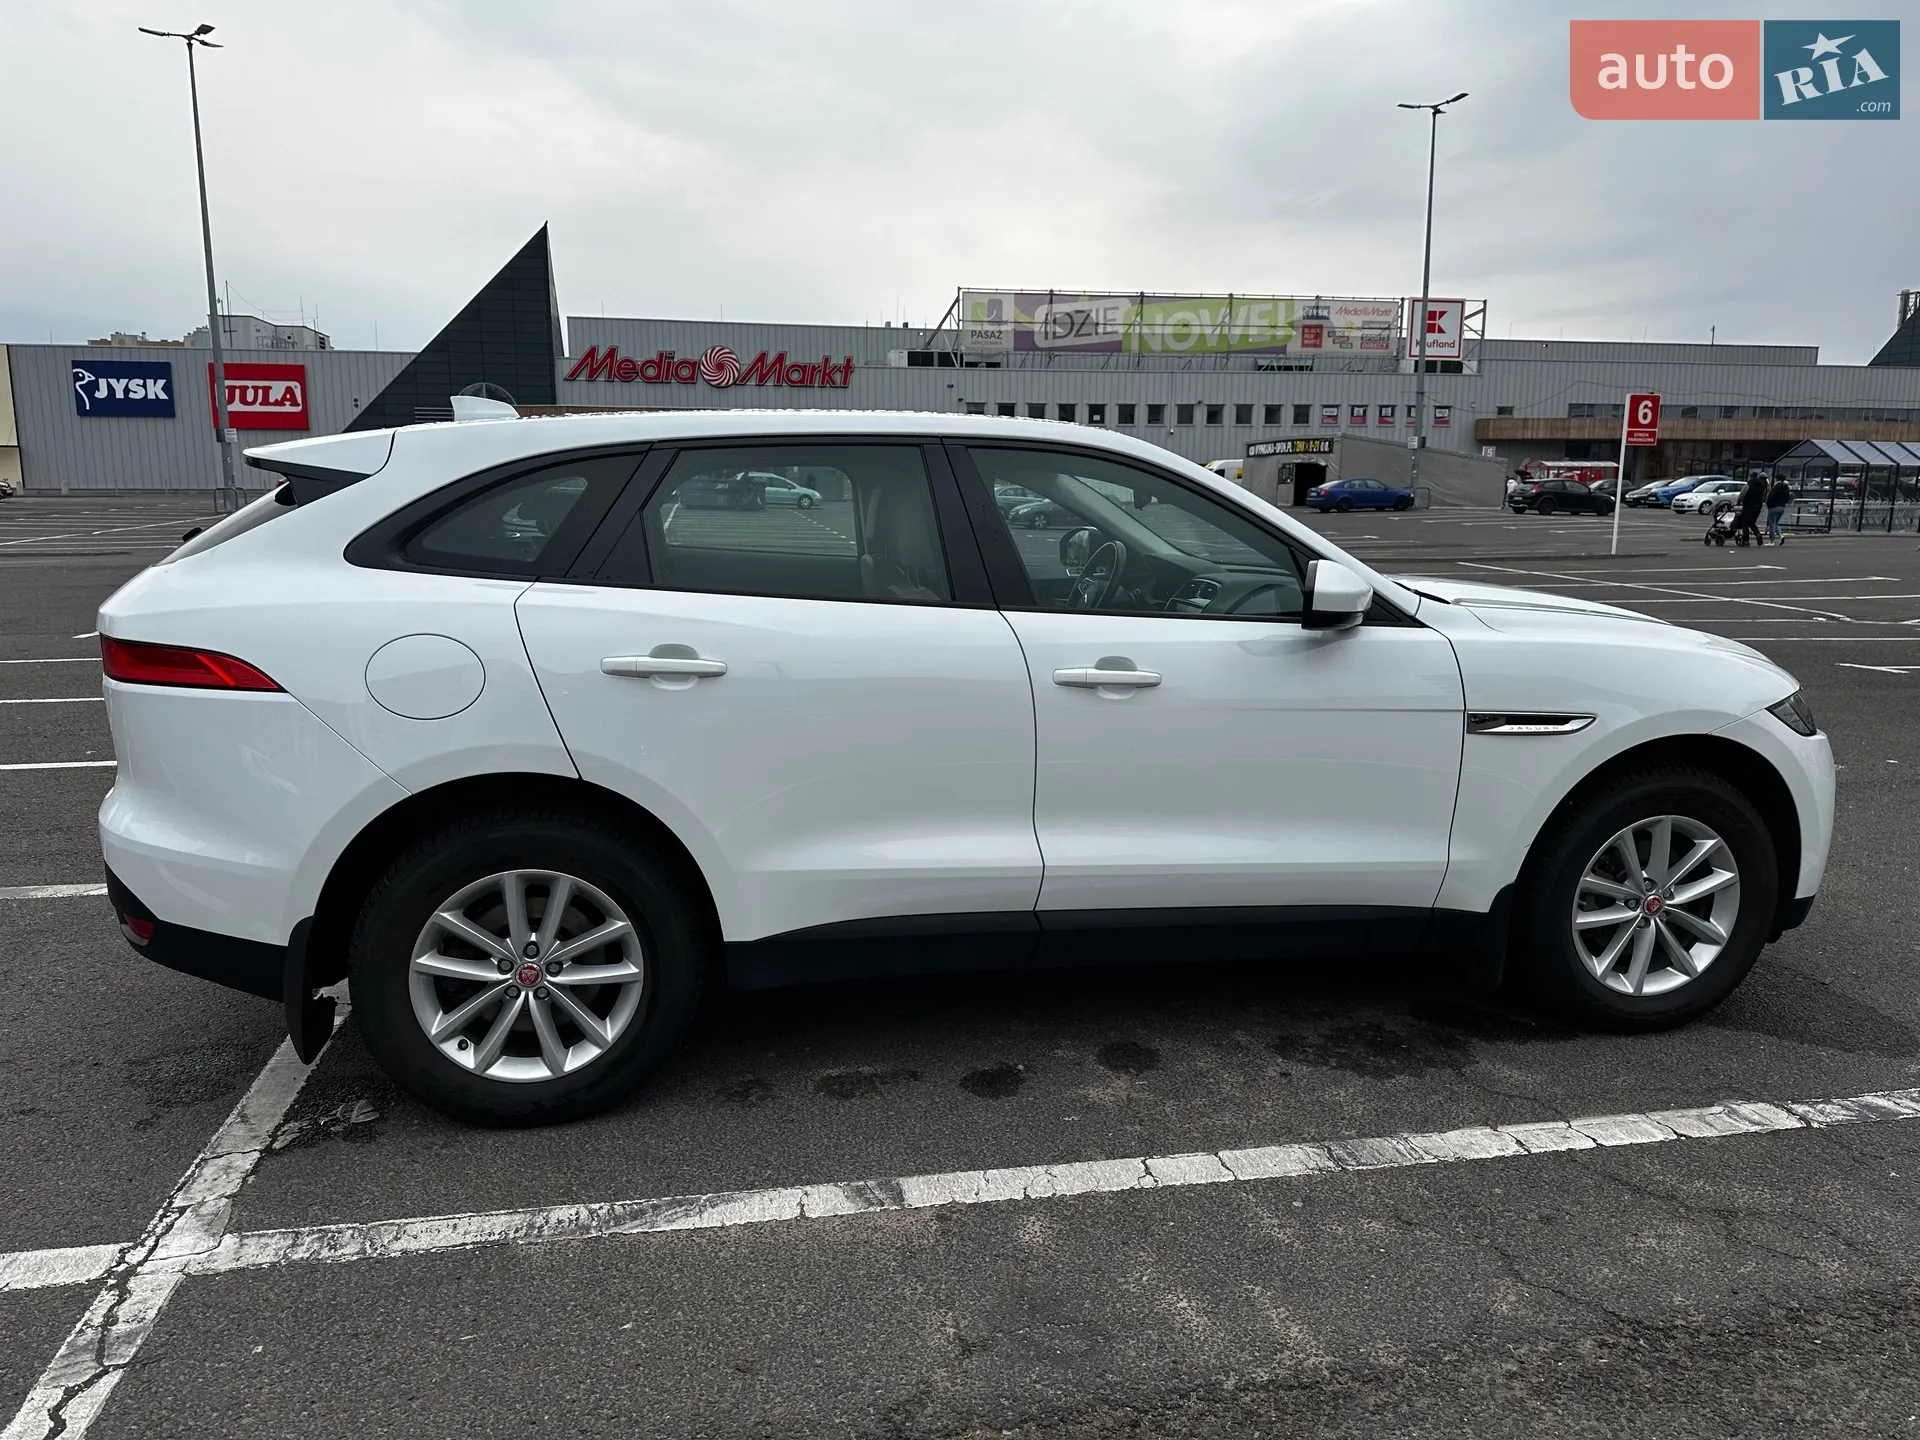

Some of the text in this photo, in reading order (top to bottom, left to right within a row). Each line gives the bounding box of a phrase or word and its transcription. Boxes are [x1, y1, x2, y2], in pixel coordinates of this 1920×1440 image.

[1308, 308, 1329, 317] JYSK
[971, 328, 1003, 340] PASAŻ
[1044, 300, 1287, 352] IDZIE NOWE!
[1415, 339, 1455, 348] Kufland
[565, 345, 854, 387] Media Markt
[94, 378, 169, 400] JYSK
[225, 385, 301, 407] JULA
[1638, 400, 1653, 425] 6
[1486, 448, 1493, 457] 5
